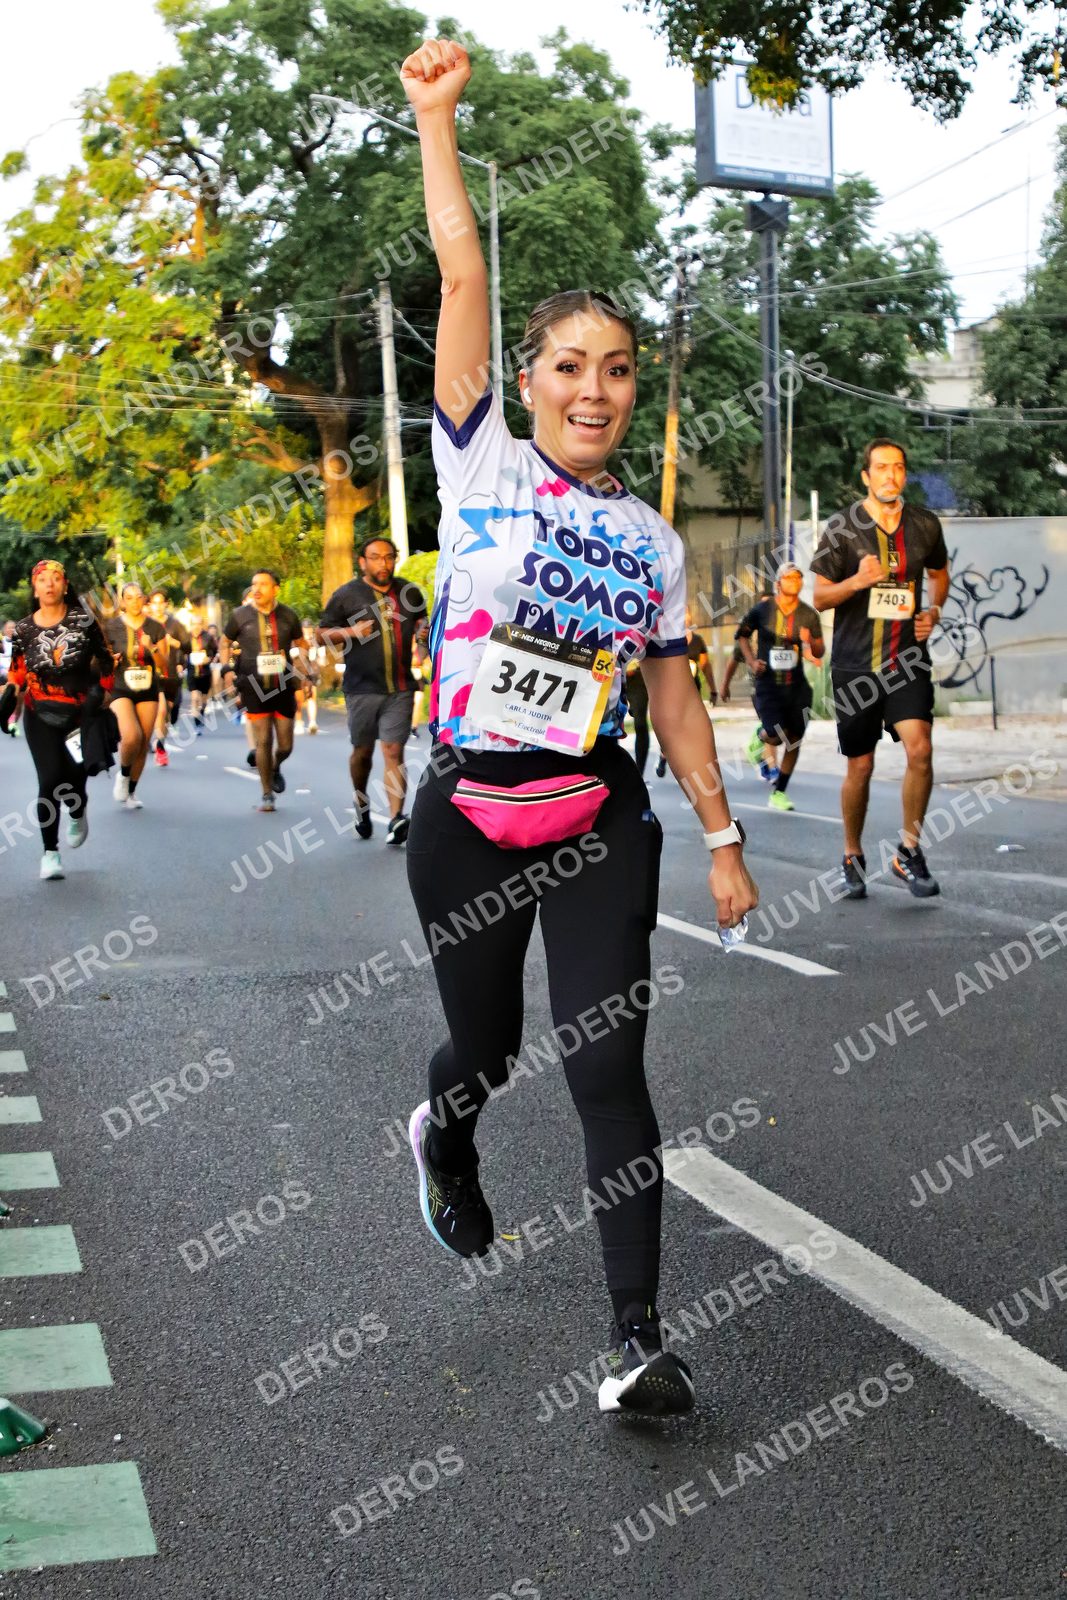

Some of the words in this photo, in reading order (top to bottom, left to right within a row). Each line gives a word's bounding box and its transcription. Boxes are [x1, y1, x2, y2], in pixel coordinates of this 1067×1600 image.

[534, 511, 654, 588] TODOS
[516, 552, 660, 632] SOMOS
[877, 593, 906, 605] 7403
[534, 637, 560, 650] NEGROS
[491, 660, 578, 714] 3471
[504, 703, 527, 714] CARLA
[528, 710, 553, 721] JUDITH
